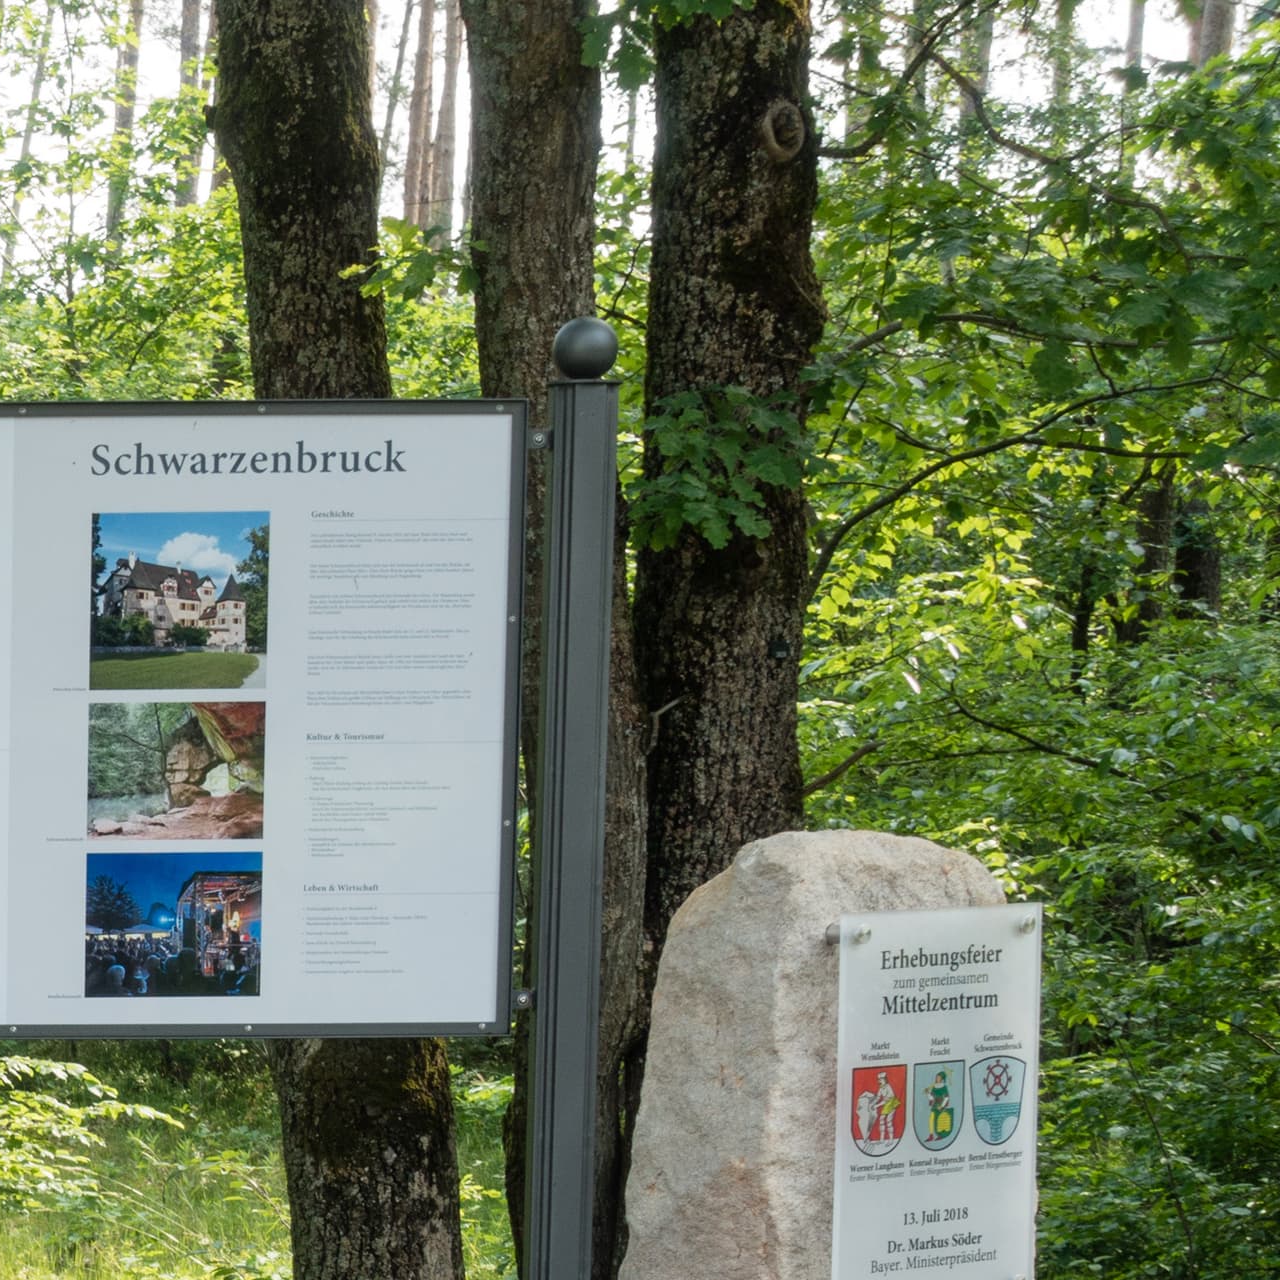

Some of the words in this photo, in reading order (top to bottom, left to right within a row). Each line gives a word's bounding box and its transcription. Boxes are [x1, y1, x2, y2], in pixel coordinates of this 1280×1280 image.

[90, 439, 406, 477] Schwarzenbruck
[310, 509, 354, 518] Geschichte
[306, 733, 332, 741] Kultur
[303, 884, 327, 892] Leben
[338, 884, 379, 892] Wirtschaft
[880, 944, 1002, 971] Erhebungsfeier
[893, 978, 916, 989] zum
[918, 972, 989, 992] gemeinsamen
[882, 992, 999, 1015] Mittelzentrum
[870, 1042, 890, 1050] Markt
[931, 1037, 950, 1046] Markt
[903, 1212, 919, 1226] 13.
[921, 1208, 941, 1226] Juli
[943, 1207, 969, 1222] 2018
[887, 1240, 905, 1254] Dr.
[908, 1235, 949, 1252] Markus
[951, 1232, 983, 1247] Söder
[870, 1259, 903, 1277] Bayer.
[906, 1249, 997, 1270] Ministerpräsident
